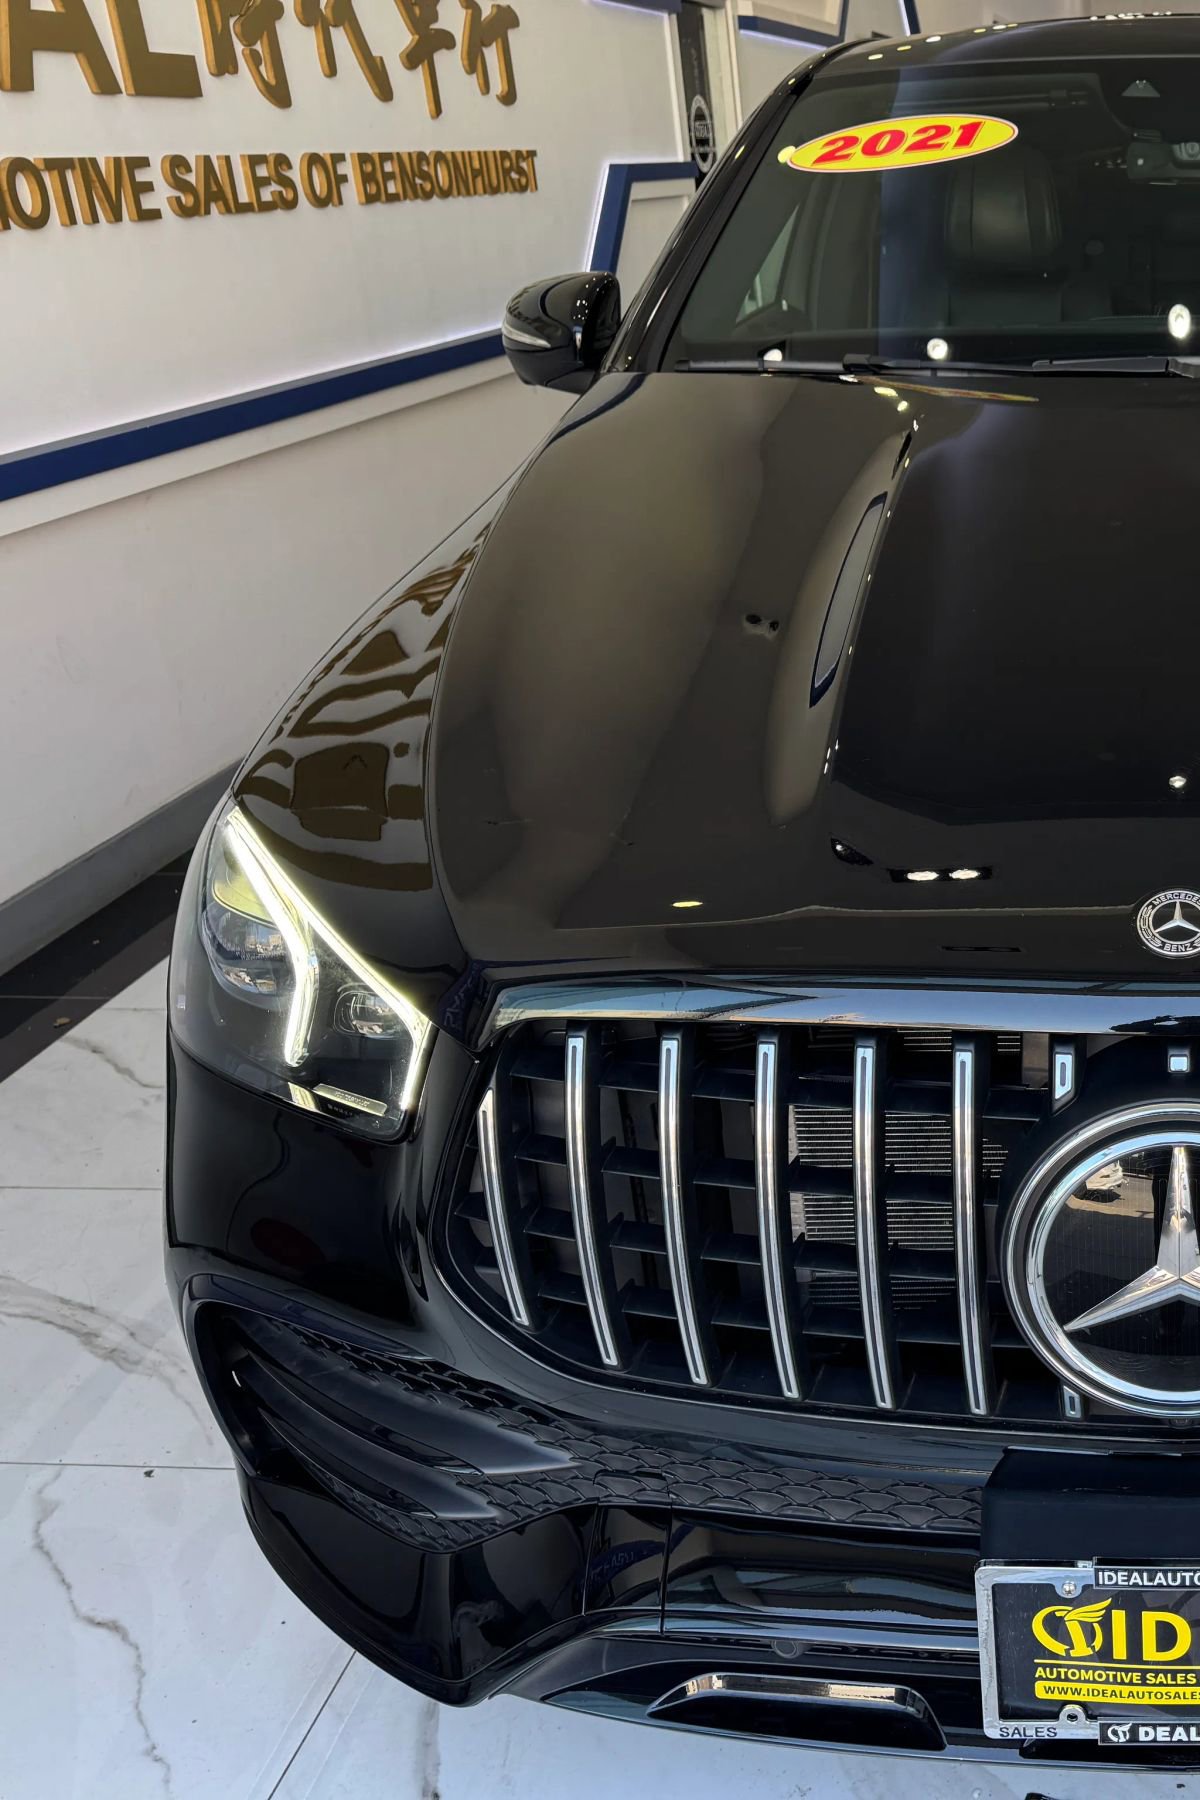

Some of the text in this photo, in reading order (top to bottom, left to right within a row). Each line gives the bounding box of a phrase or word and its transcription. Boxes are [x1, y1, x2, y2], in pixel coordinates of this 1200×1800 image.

[811, 121, 985, 166] 2021
[0, 149, 538, 232] OTIVE SALES OF BENSONHURST
[1163, 943, 1193, 952] BENZ
[1034, 1666, 1142, 1684] AUTOMOTIVE
[1145, 1673, 1196, 1685] SALES
[999, 1726, 1058, 1738] SALES
